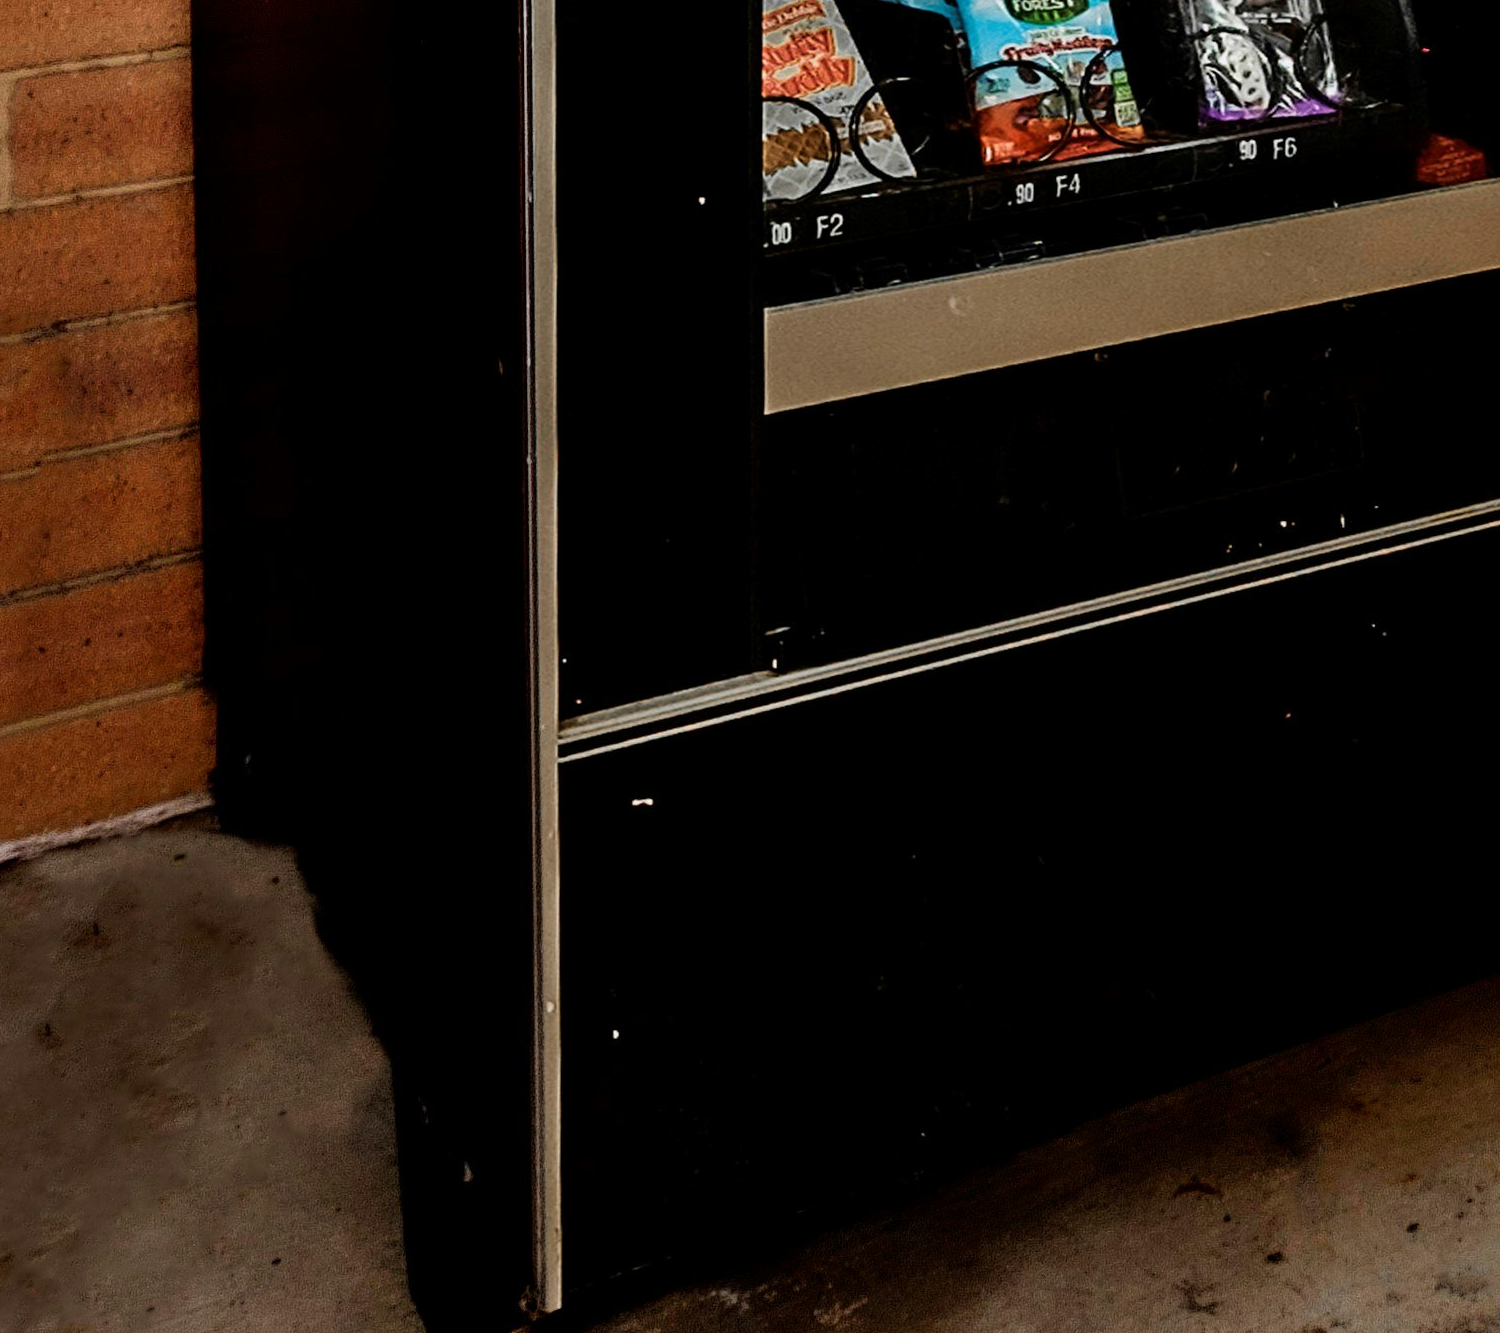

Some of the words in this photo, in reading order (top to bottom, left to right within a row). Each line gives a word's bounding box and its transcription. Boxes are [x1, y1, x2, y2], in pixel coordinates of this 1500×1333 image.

[1272, 137, 1298, 160] F6
[1055, 173, 1081, 198] F4
[816, 213, 844, 239] F2
